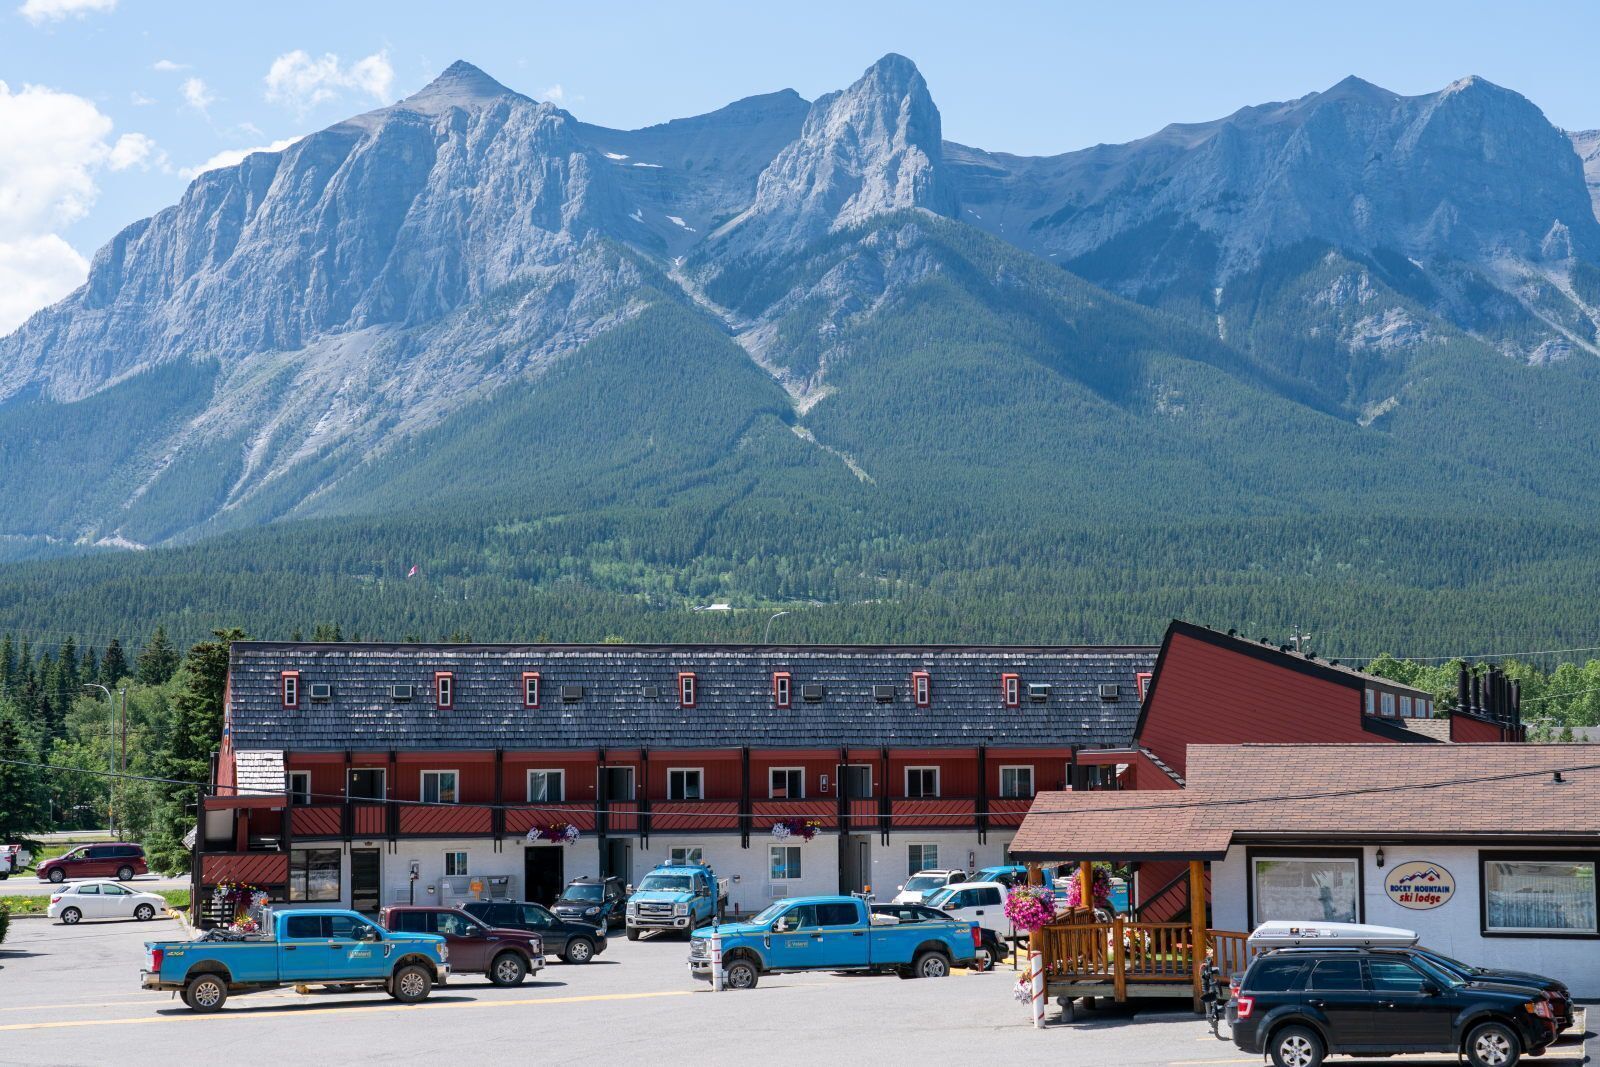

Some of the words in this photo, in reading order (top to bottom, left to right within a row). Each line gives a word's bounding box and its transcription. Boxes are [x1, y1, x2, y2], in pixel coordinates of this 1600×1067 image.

[1414, 885, 1450, 893] MOUNTAIN
[1400, 893, 1413, 902] ski
[1415, 893, 1441, 904] lodge
